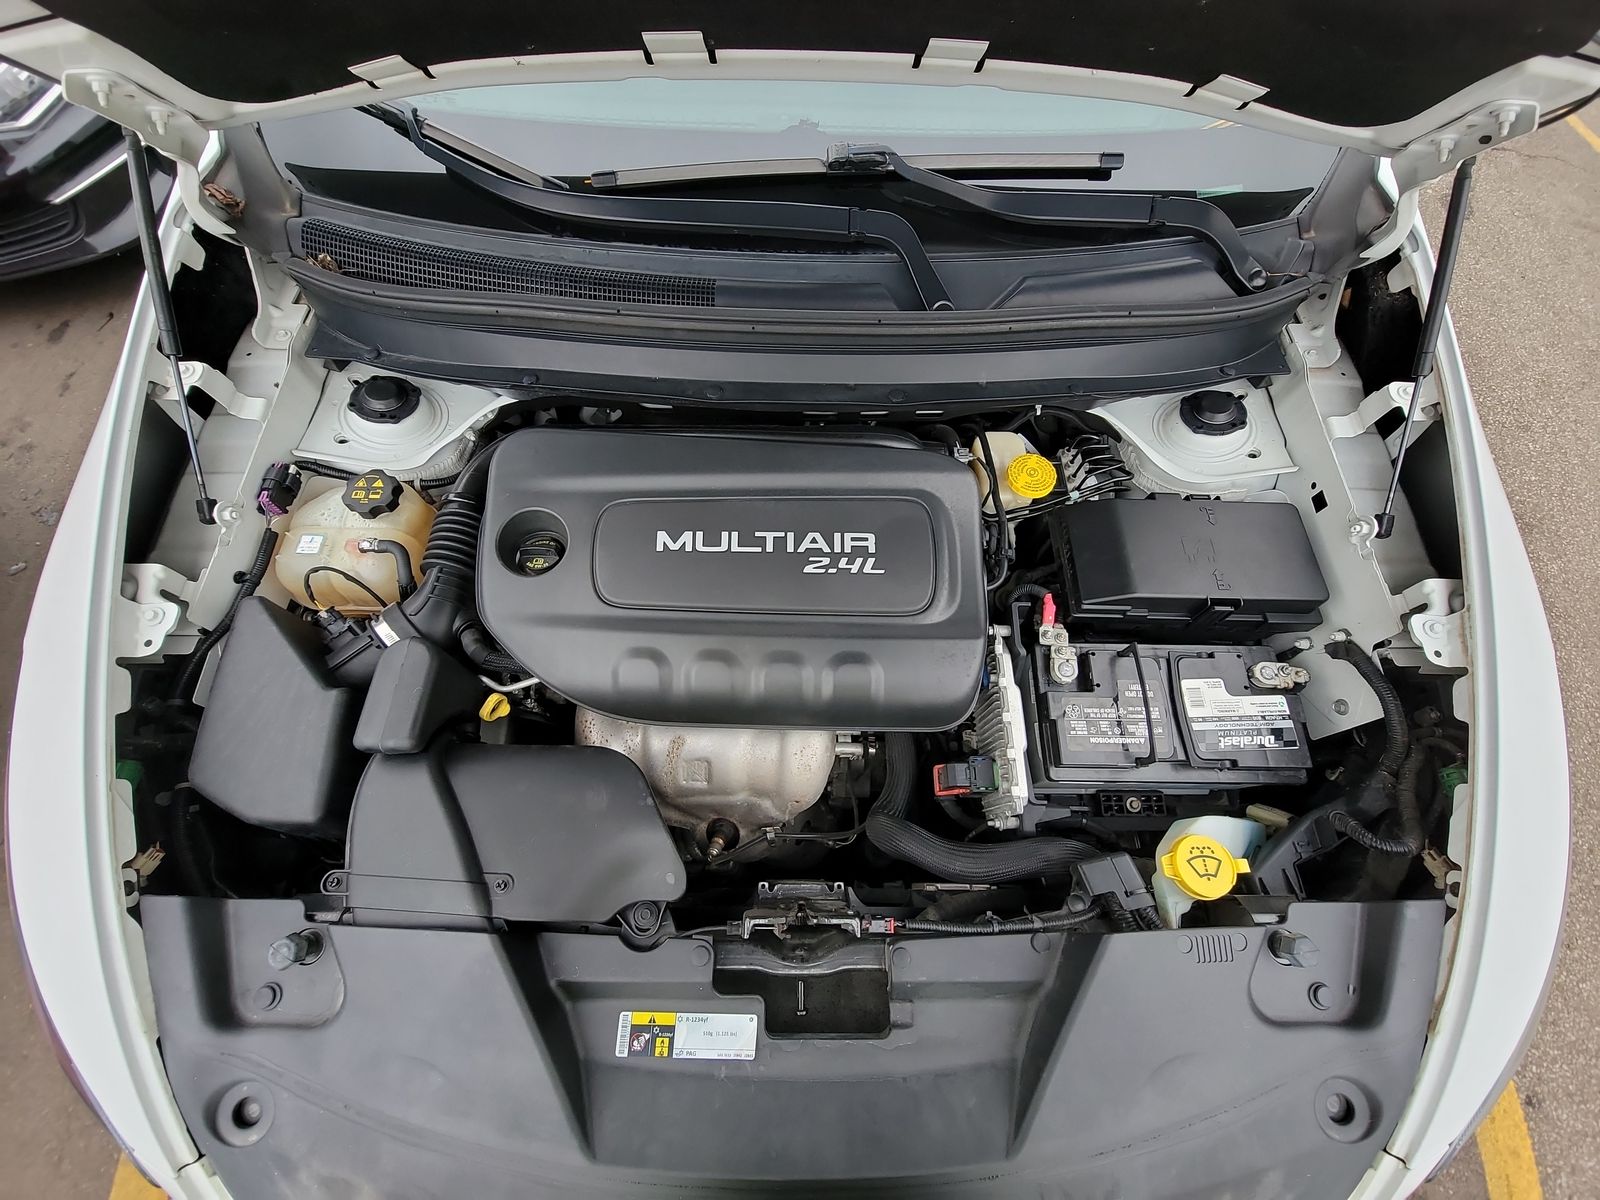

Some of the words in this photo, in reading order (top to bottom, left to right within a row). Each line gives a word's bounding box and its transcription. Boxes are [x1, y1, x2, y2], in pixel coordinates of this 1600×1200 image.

[655, 530, 876, 554] MULTIAIR
[802, 557, 886, 575] 2.4L
[1218, 736, 1279, 748] Duralast
[685, 1016, 709, 1024] R-1234yf
